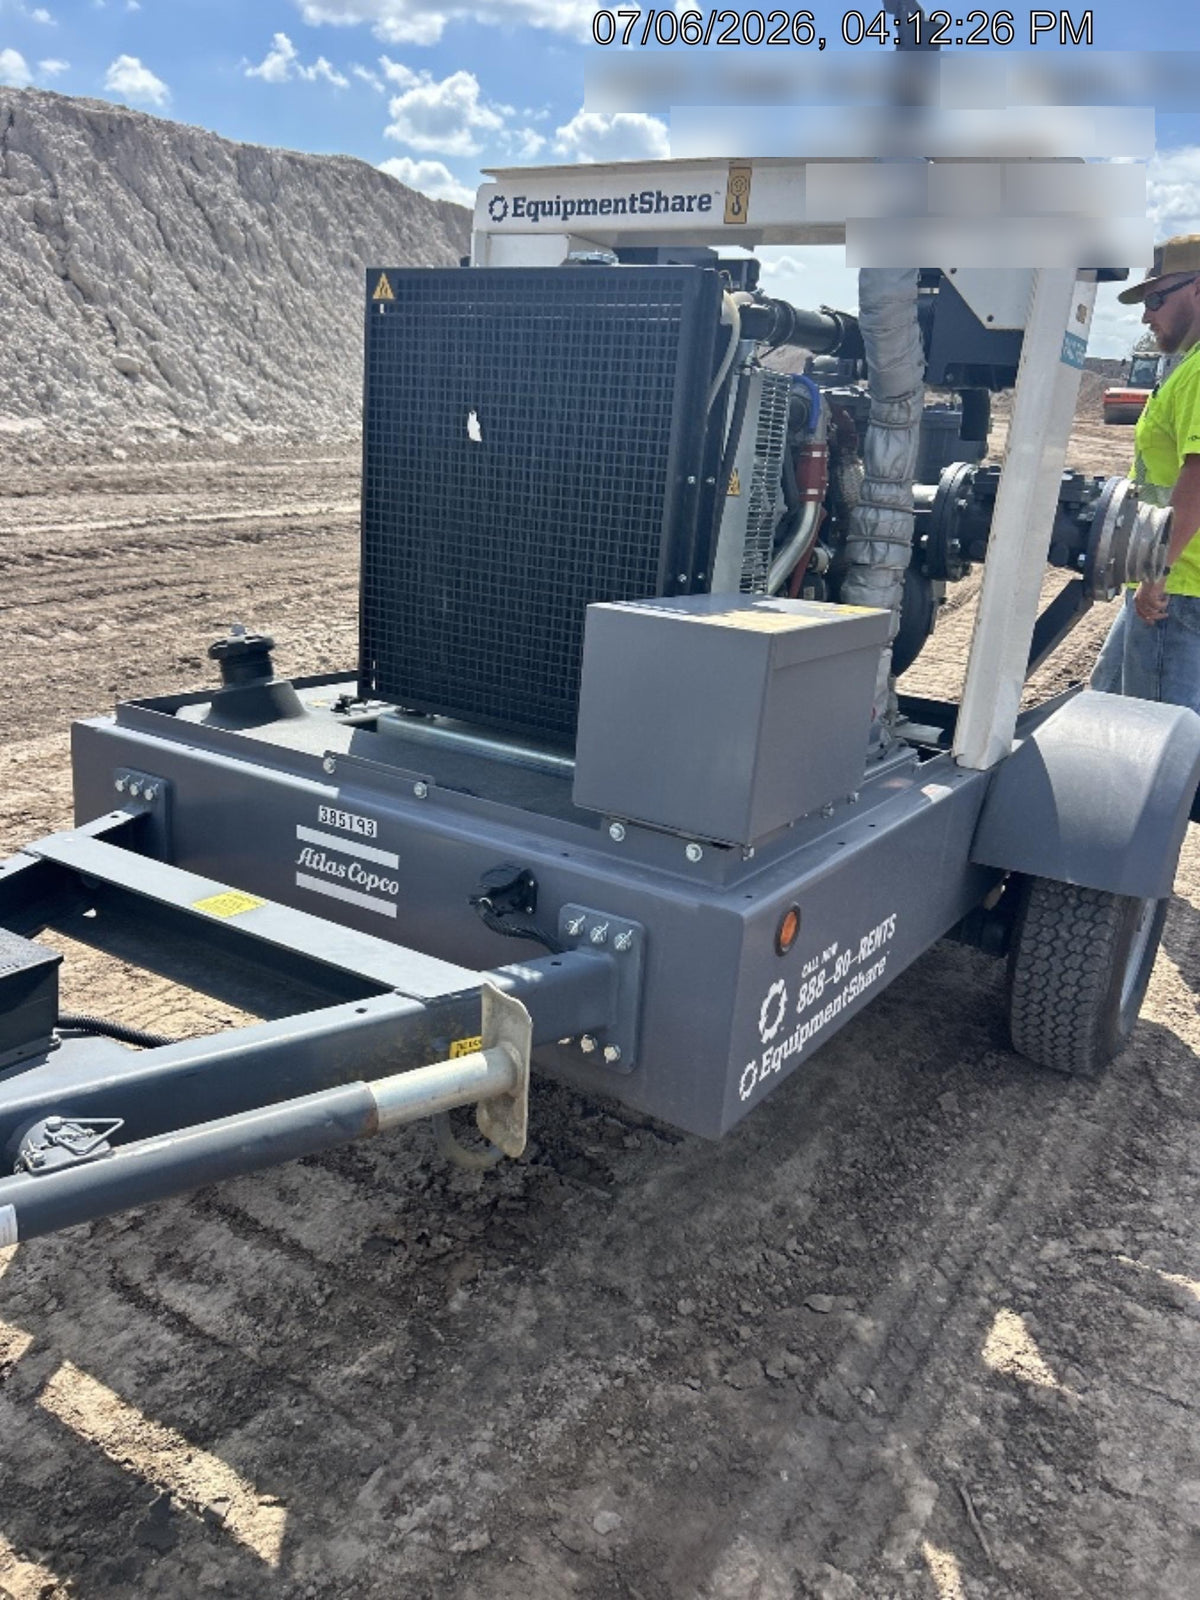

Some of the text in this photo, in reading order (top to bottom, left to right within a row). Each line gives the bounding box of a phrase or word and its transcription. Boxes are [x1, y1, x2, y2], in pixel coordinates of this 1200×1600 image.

[511, 190, 712, 223] EquipmentShare
[320, 808, 376, 837] 385193
[296, 847, 400, 895] Atlas Copco
[759, 956, 887, 1082] EquipmentShare
